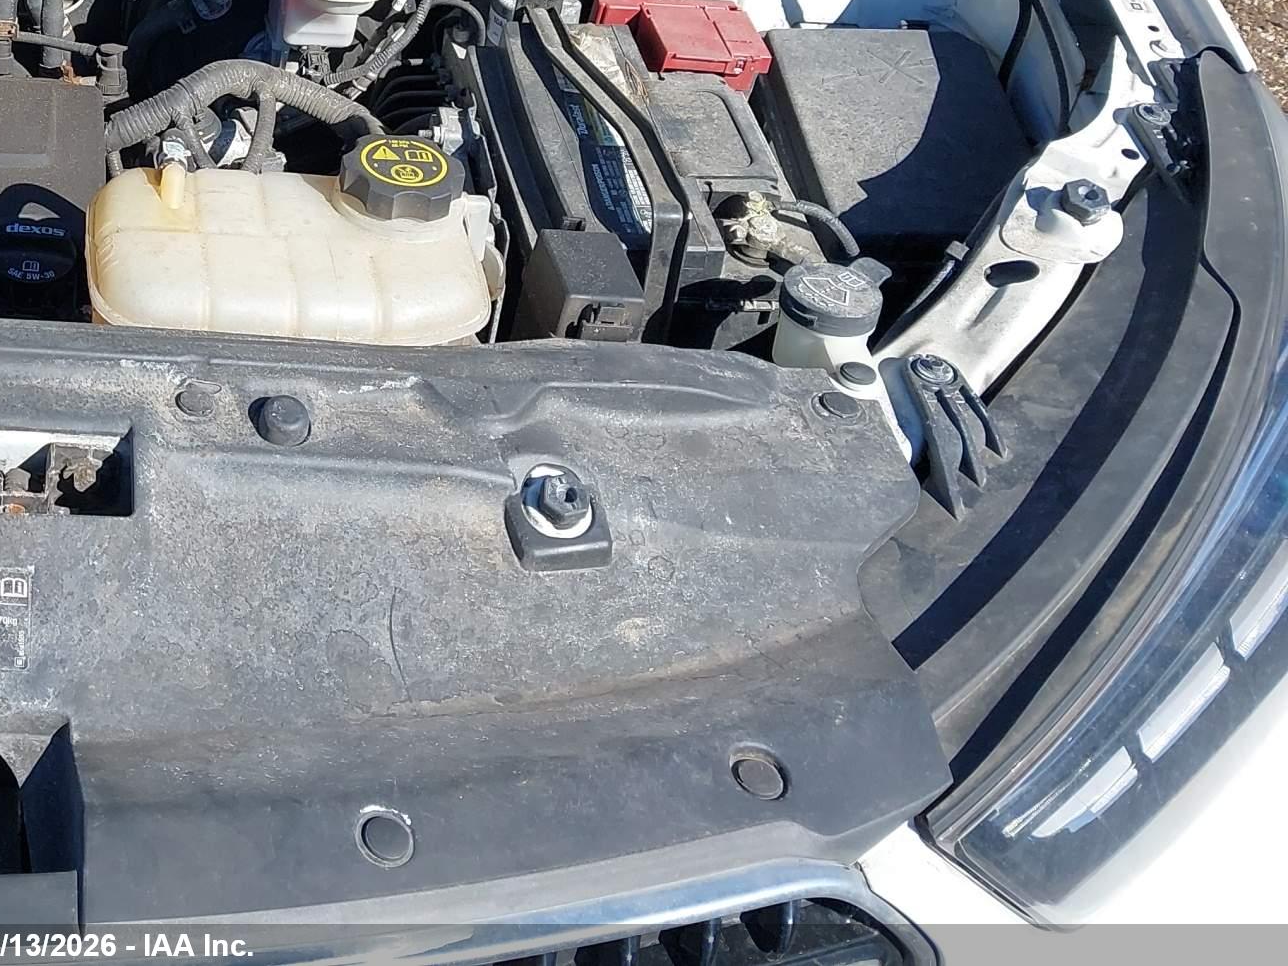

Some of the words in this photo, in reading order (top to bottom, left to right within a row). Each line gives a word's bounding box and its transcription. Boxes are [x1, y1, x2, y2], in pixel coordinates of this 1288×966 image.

[6, 223, 66, 236] dexos
[7, 267, 24, 279] SAE
[26, 270, 55, 280] 5W-30
